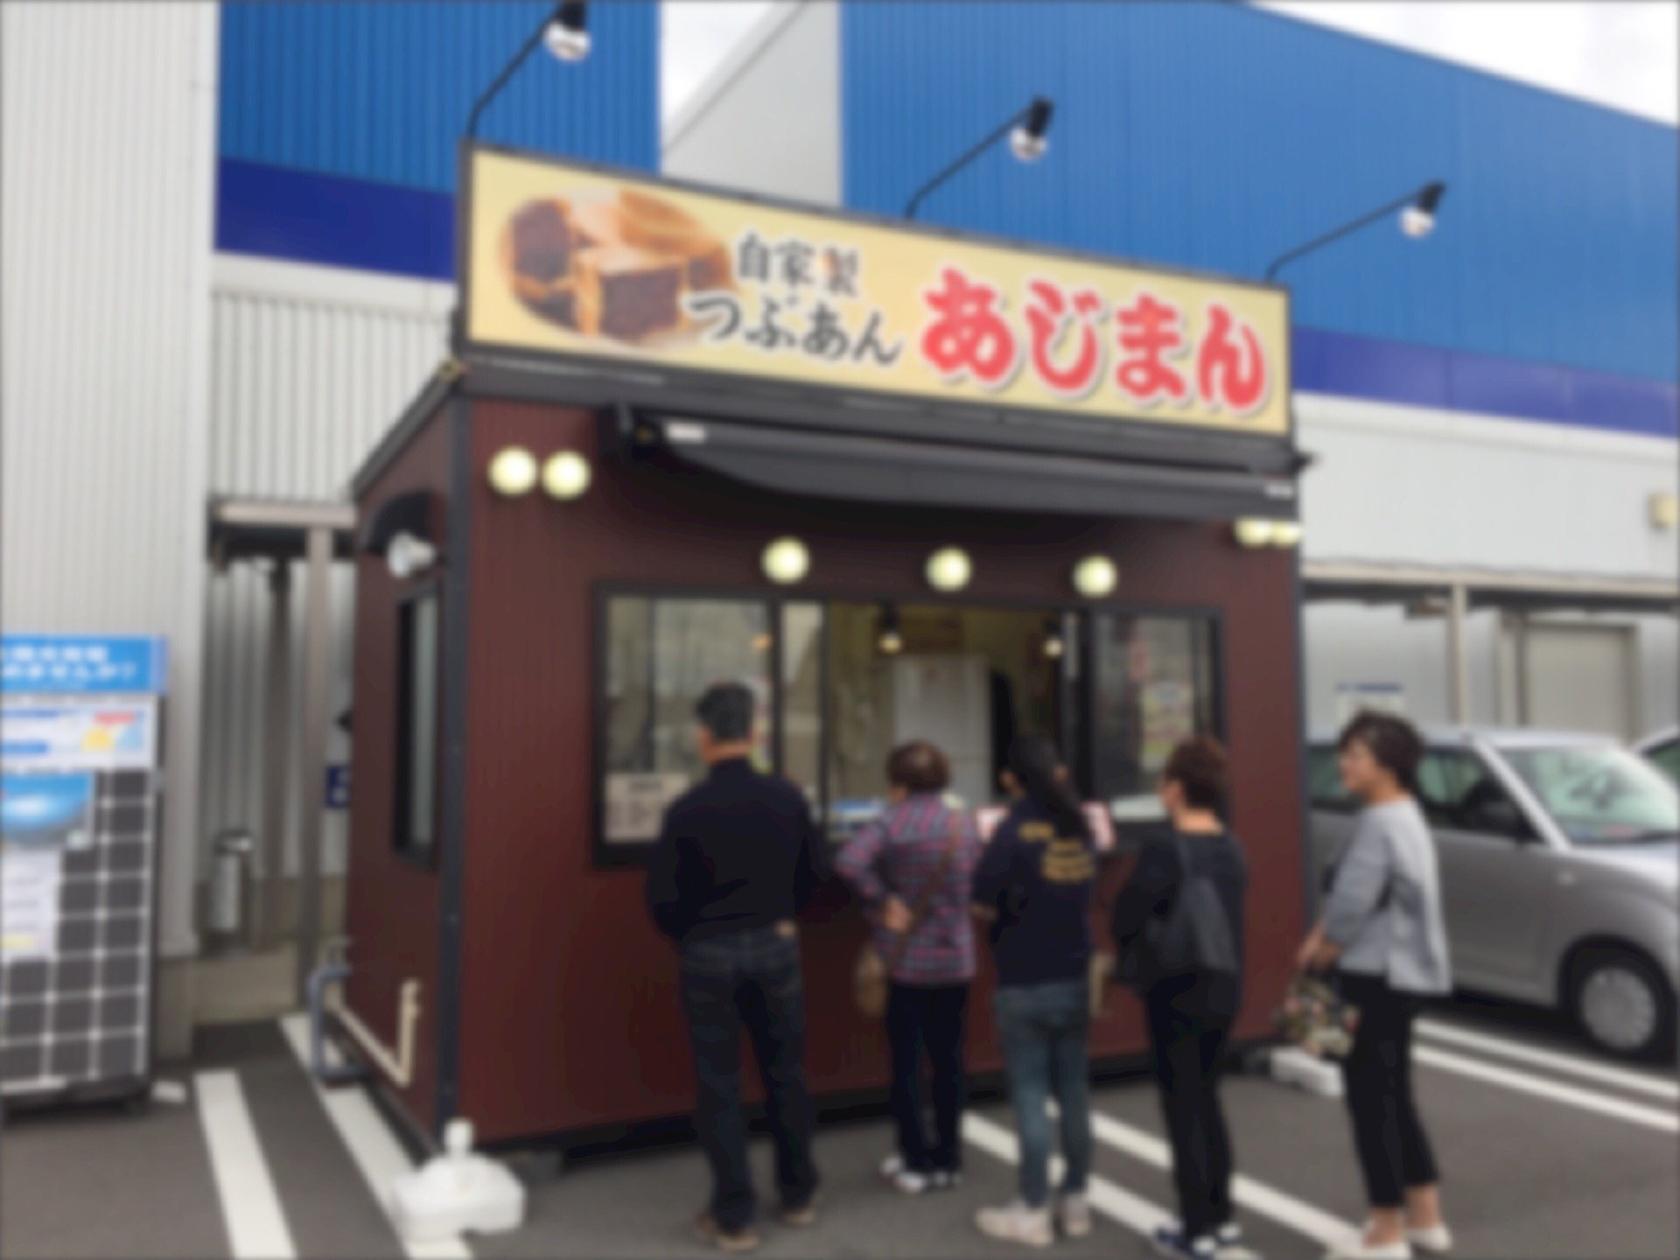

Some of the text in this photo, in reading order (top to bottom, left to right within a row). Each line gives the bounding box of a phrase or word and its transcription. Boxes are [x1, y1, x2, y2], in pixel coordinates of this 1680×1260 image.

[738, 232, 859, 295] 自家製
[690, 294, 901, 364] つぶあん
[921, 267, 1267, 409] あじまん
